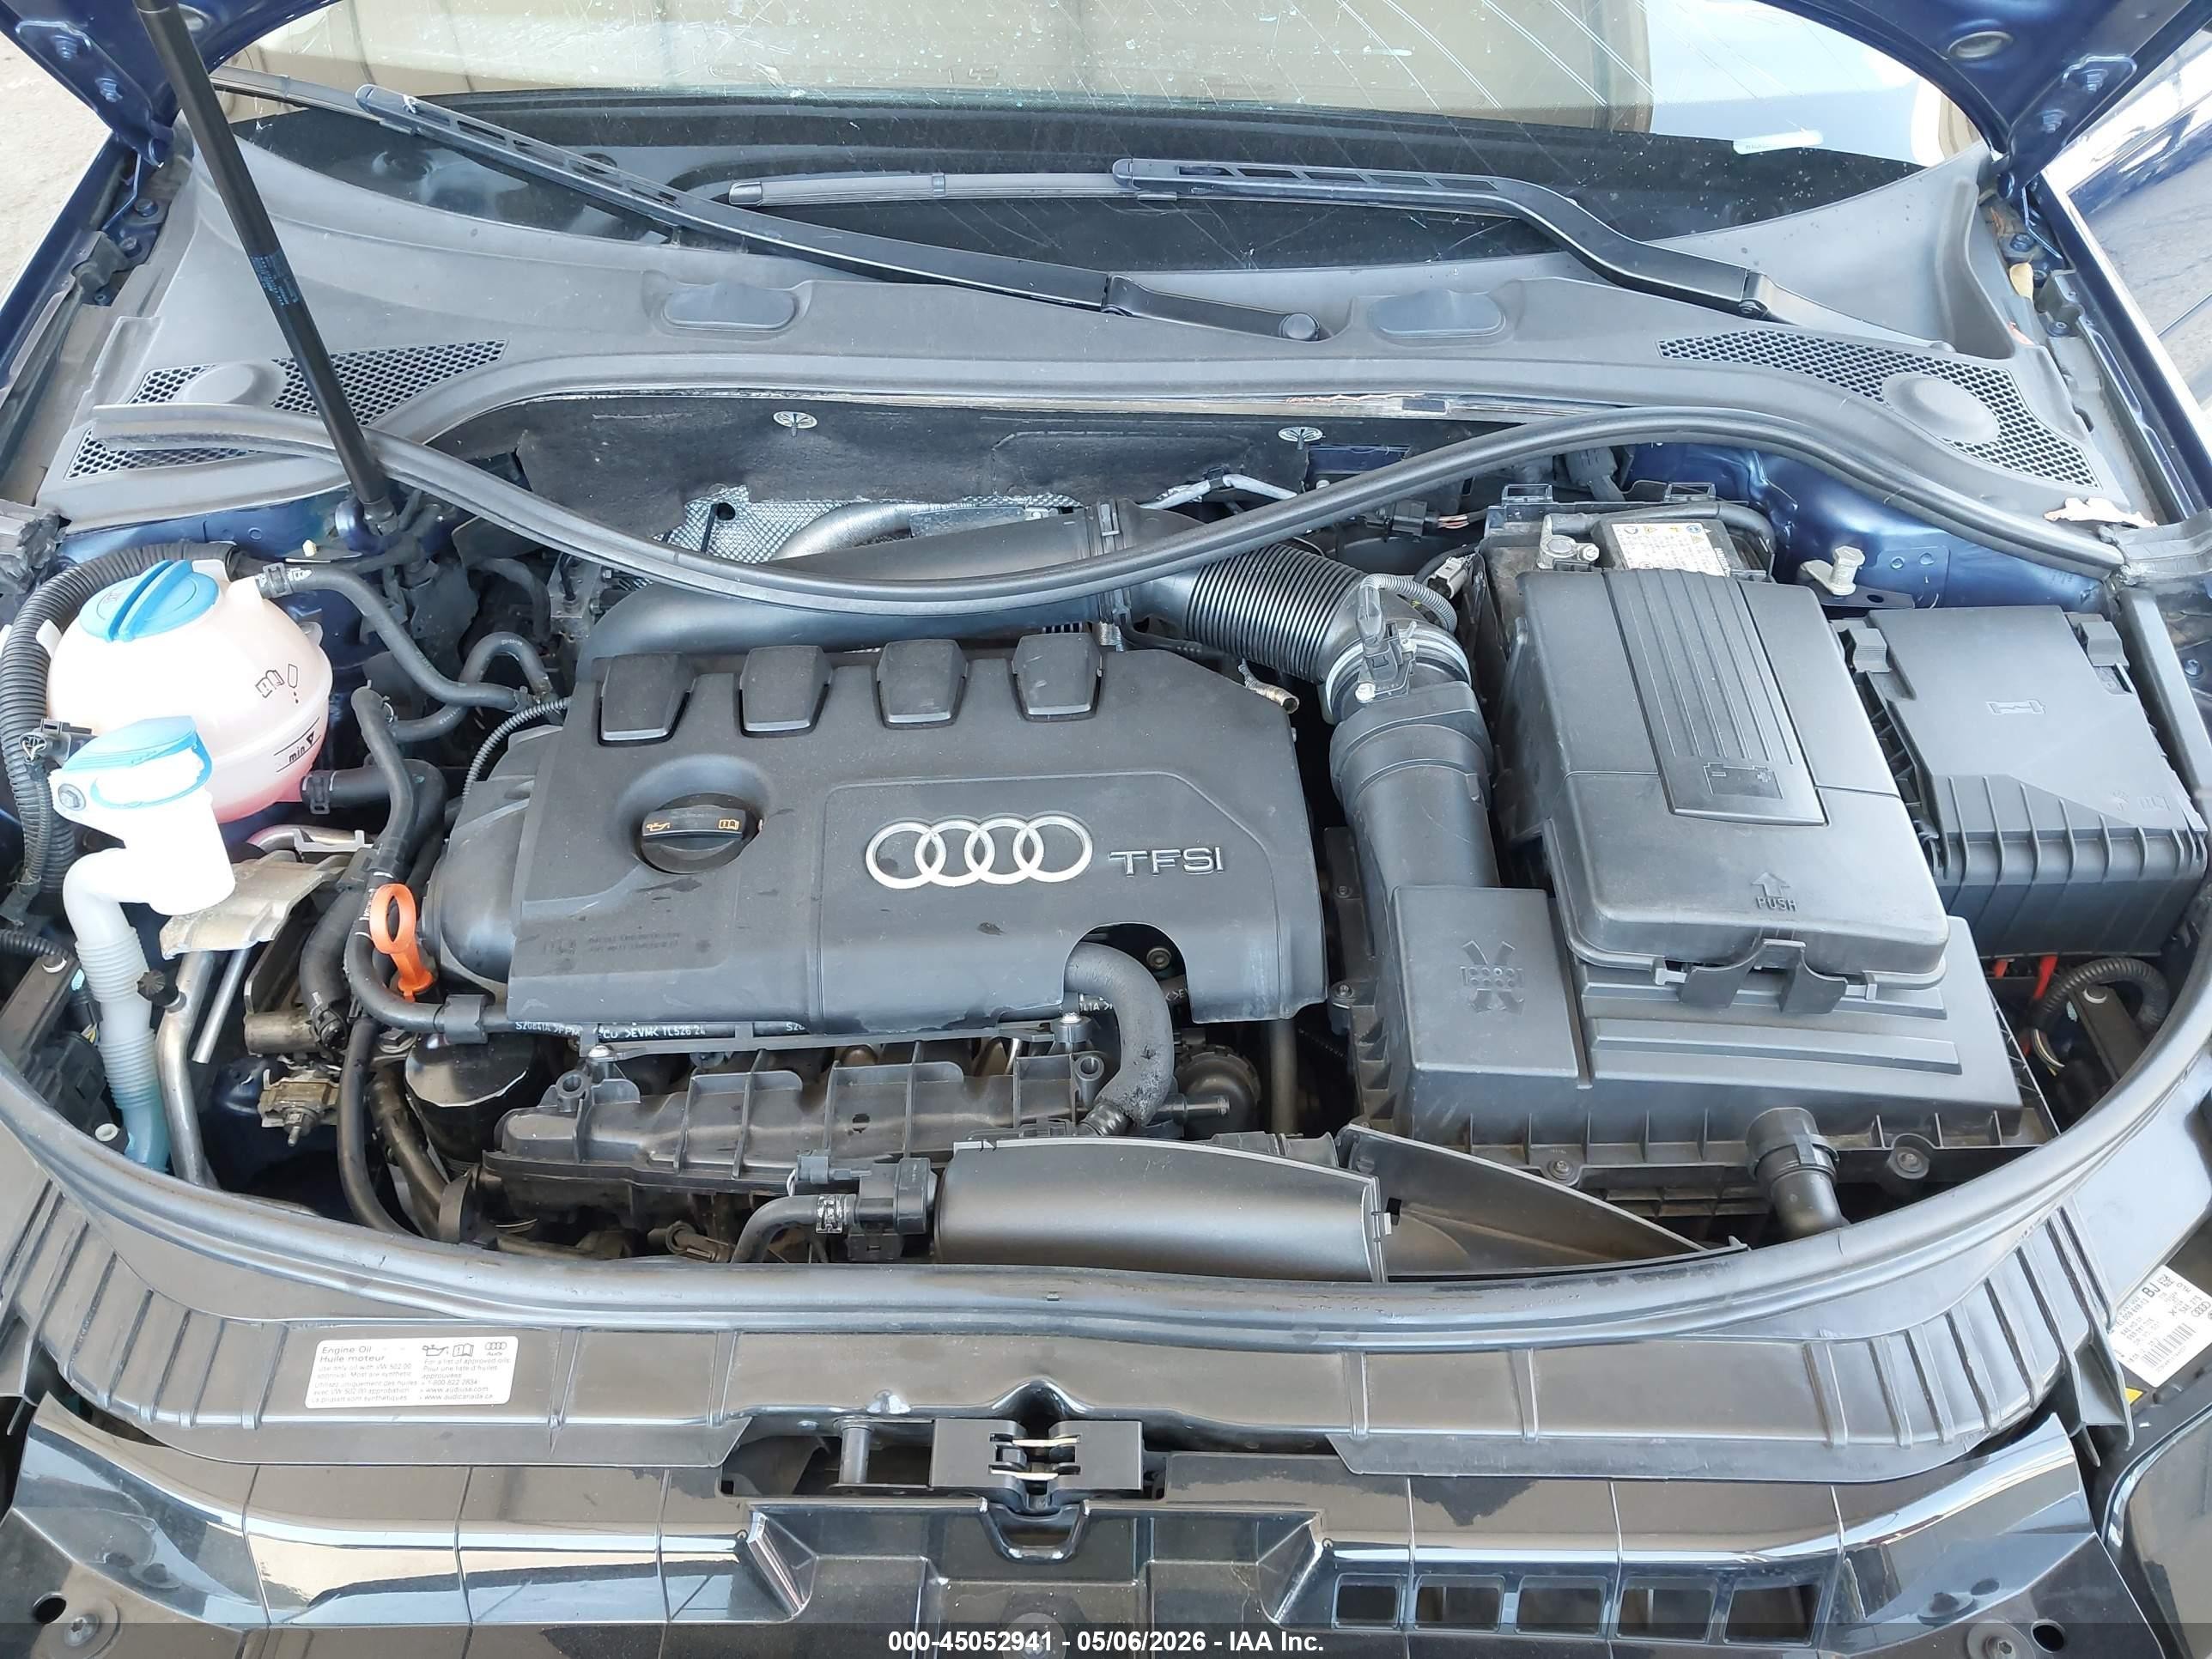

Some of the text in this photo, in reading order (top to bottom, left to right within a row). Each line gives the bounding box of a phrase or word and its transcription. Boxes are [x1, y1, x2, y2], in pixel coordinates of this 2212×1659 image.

[289, 745, 306, 763] min
[1108, 846, 1224, 877] TFSI
[1756, 896, 1797, 911] PUSH
[2142, 1282, 2160, 1297] BJ
[322, 1346, 355, 1355] Engine
